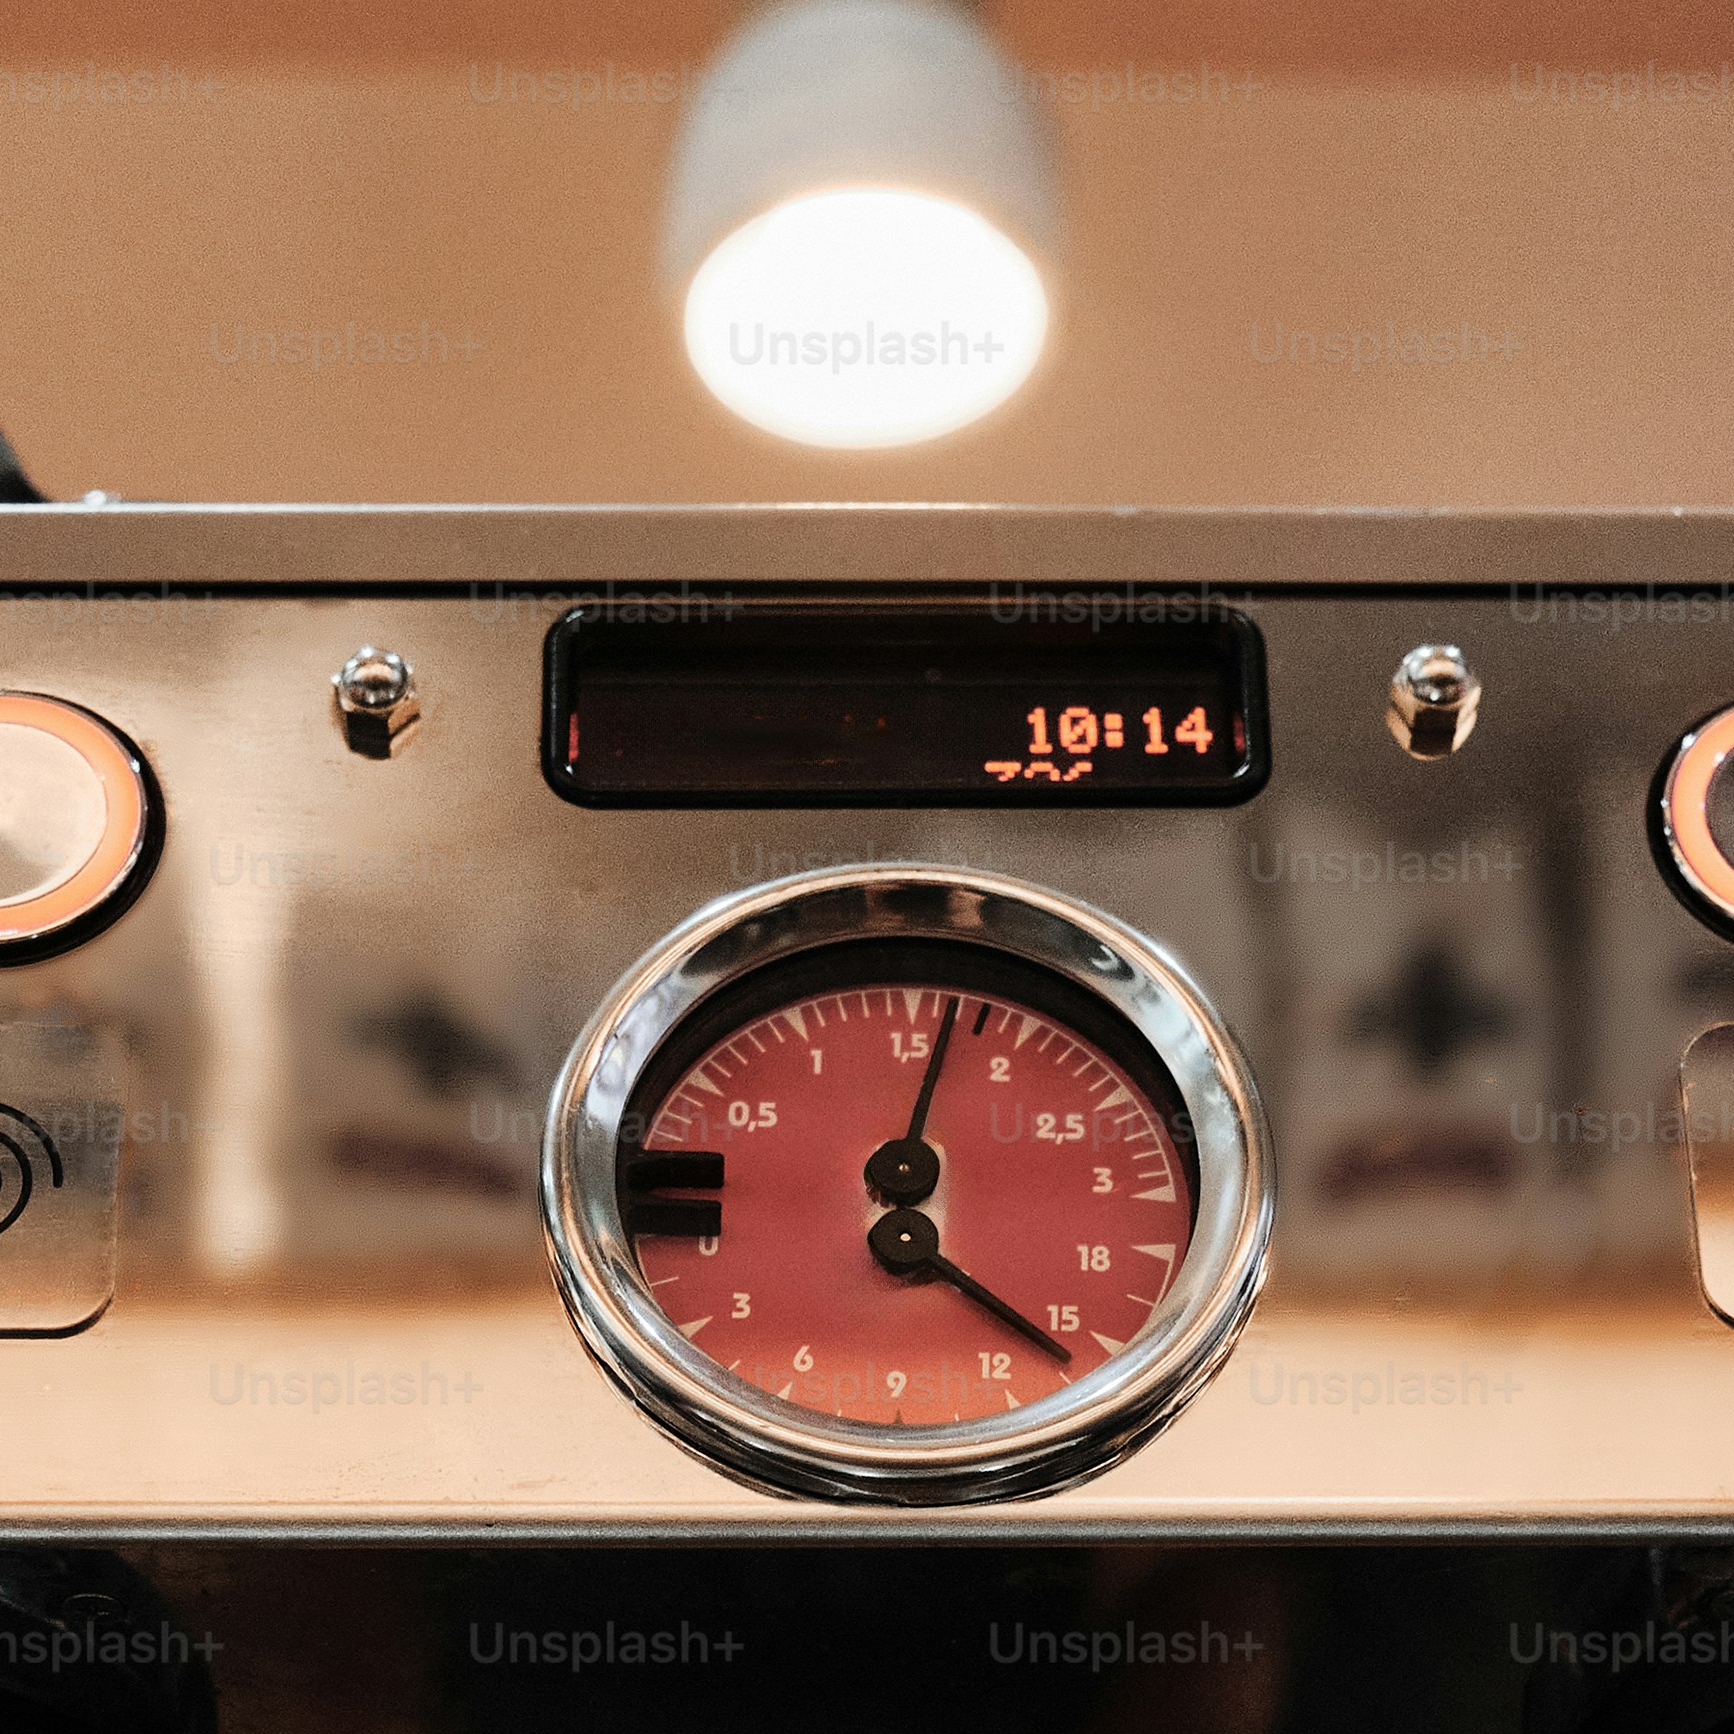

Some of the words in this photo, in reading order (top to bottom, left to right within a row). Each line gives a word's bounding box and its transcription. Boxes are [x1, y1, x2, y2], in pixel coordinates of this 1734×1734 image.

[1026, 706, 1214, 754] 10:14
[890, 1032, 930, 1063] 1,5
[810, 1049, 822, 1075] 1
[989, 1056, 1011, 1082] 2
[727, 1101, 778, 1132] 0,5
[1035, 1113, 1085, 1145] 2,5
[1092, 1167, 1114, 1193] 3
[1076, 1244, 1111, 1272] 18
[731, 1292, 752, 1319] 3
[1047, 1304, 1080, 1332] 15
[793, 1345, 814, 1372] 6
[978, 1352, 1012, 1380] 12
[886, 1370, 907, 1398] 9
